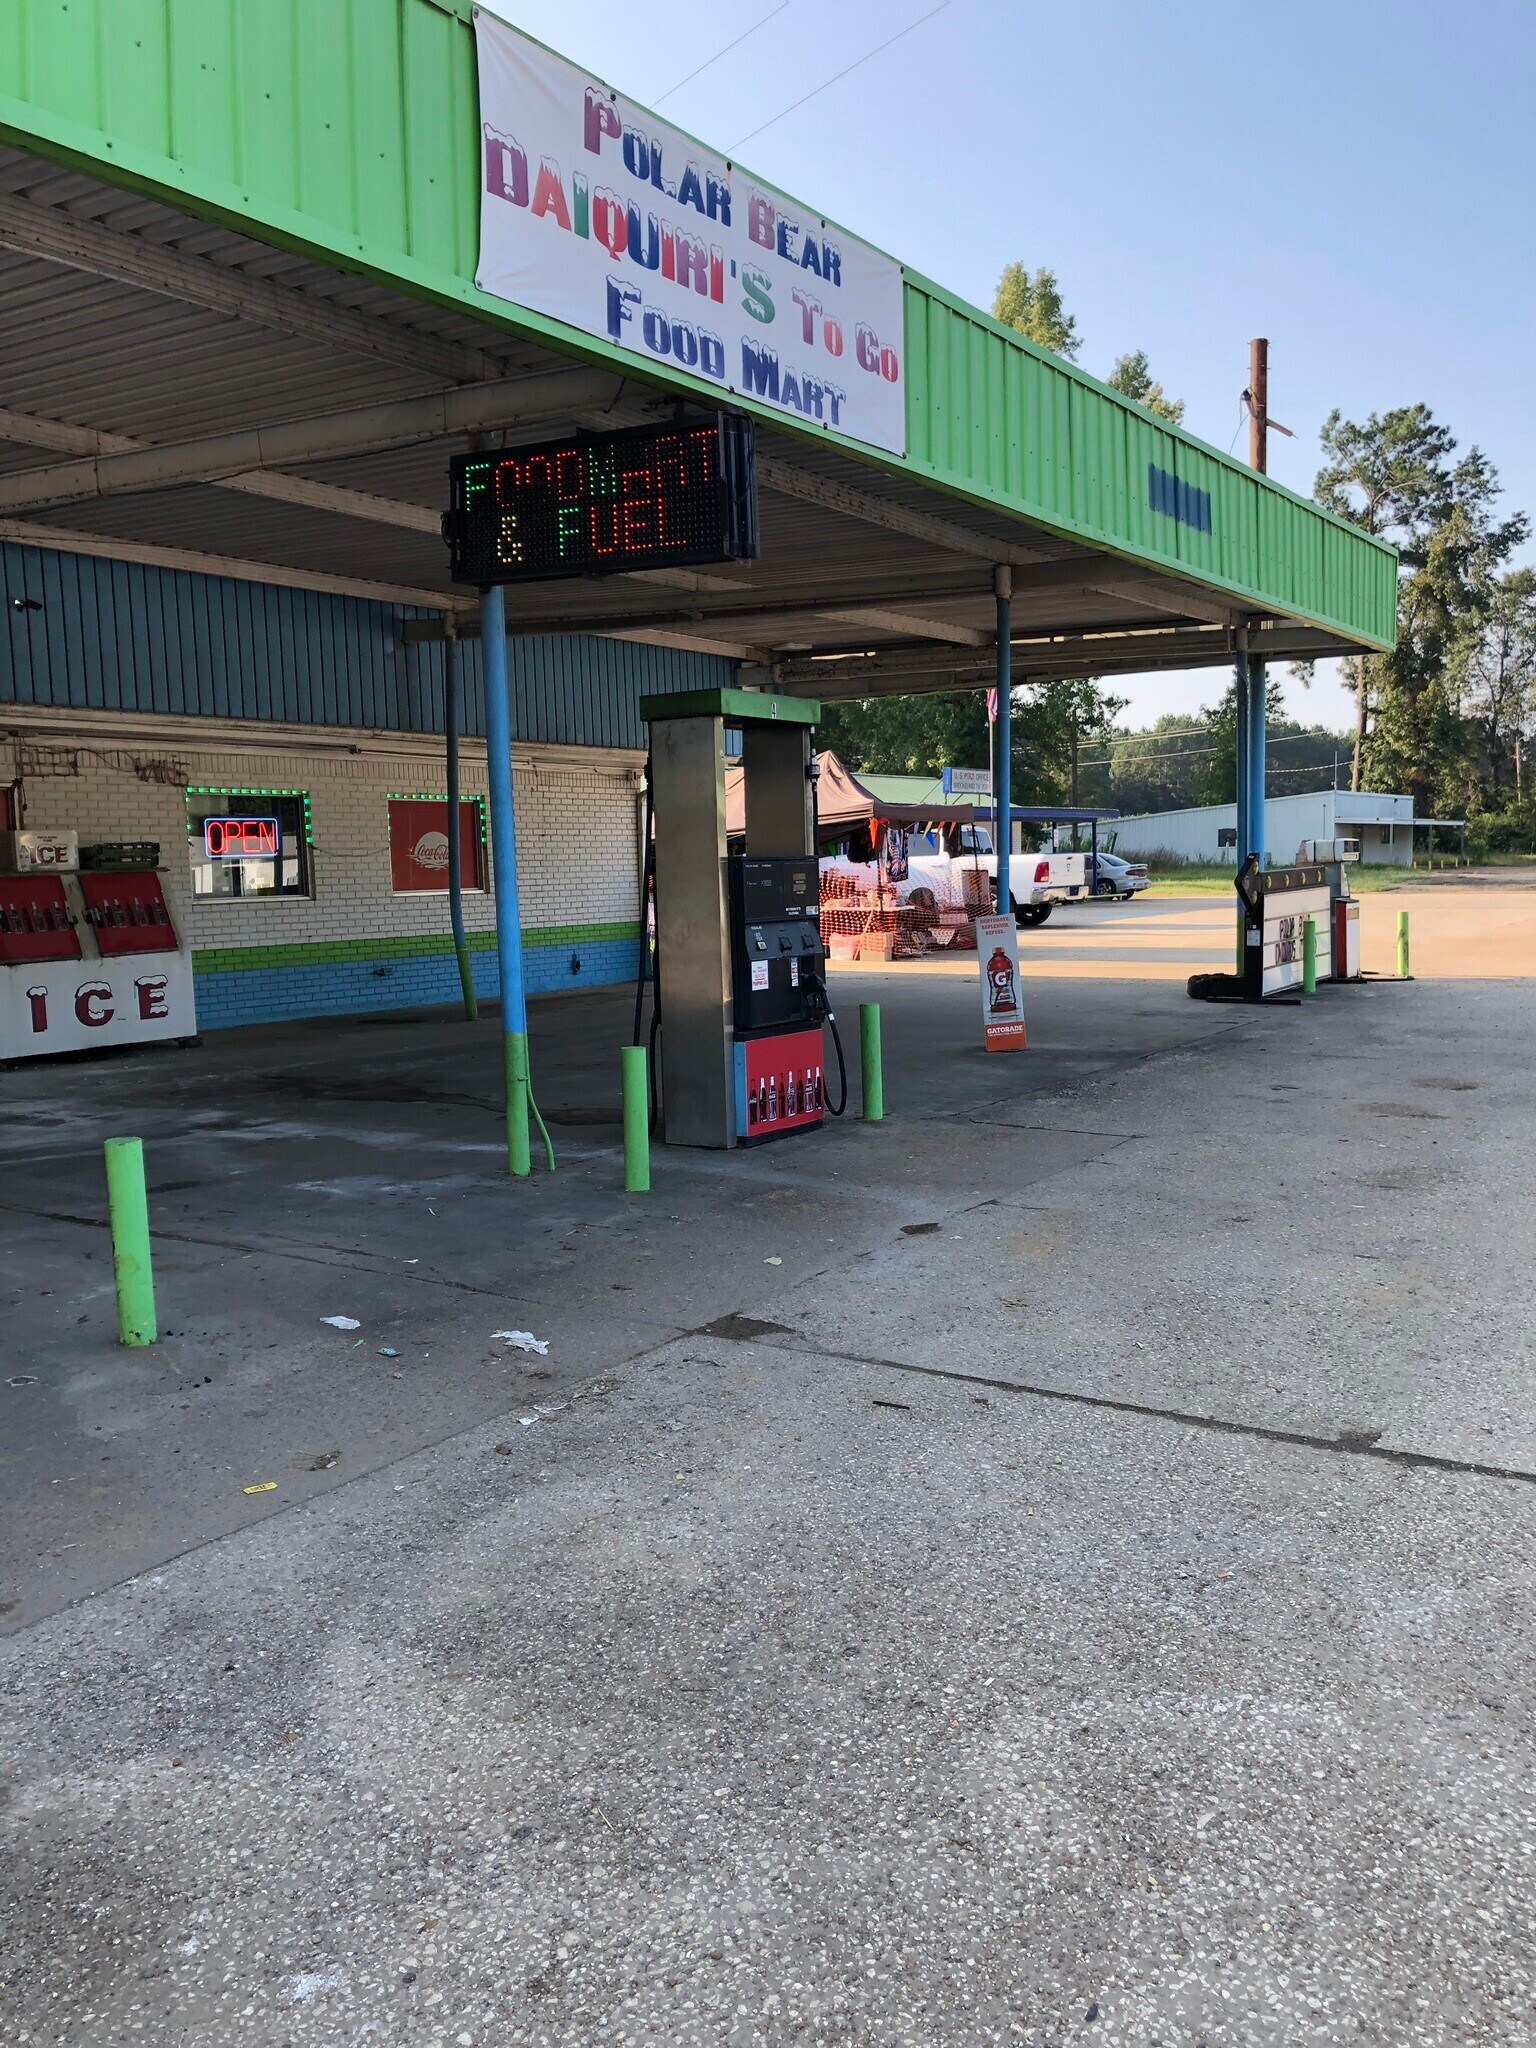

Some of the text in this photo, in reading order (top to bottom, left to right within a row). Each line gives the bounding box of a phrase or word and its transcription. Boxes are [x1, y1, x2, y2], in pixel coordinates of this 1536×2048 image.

[584, 86, 841, 287] POLAR BEAR
[483, 121, 776, 324] DAIQUIRI'S
[606, 273, 847, 426] FOOD MART
[496, 497, 688, 564] & FUEL
[28, 843, 69, 864] ICE
[207, 821, 276, 854] OPEN
[26, 974, 169, 1033] ICE
[994, 971, 1007, 986] G
[987, 1025, 1024, 1034] GATORADE
